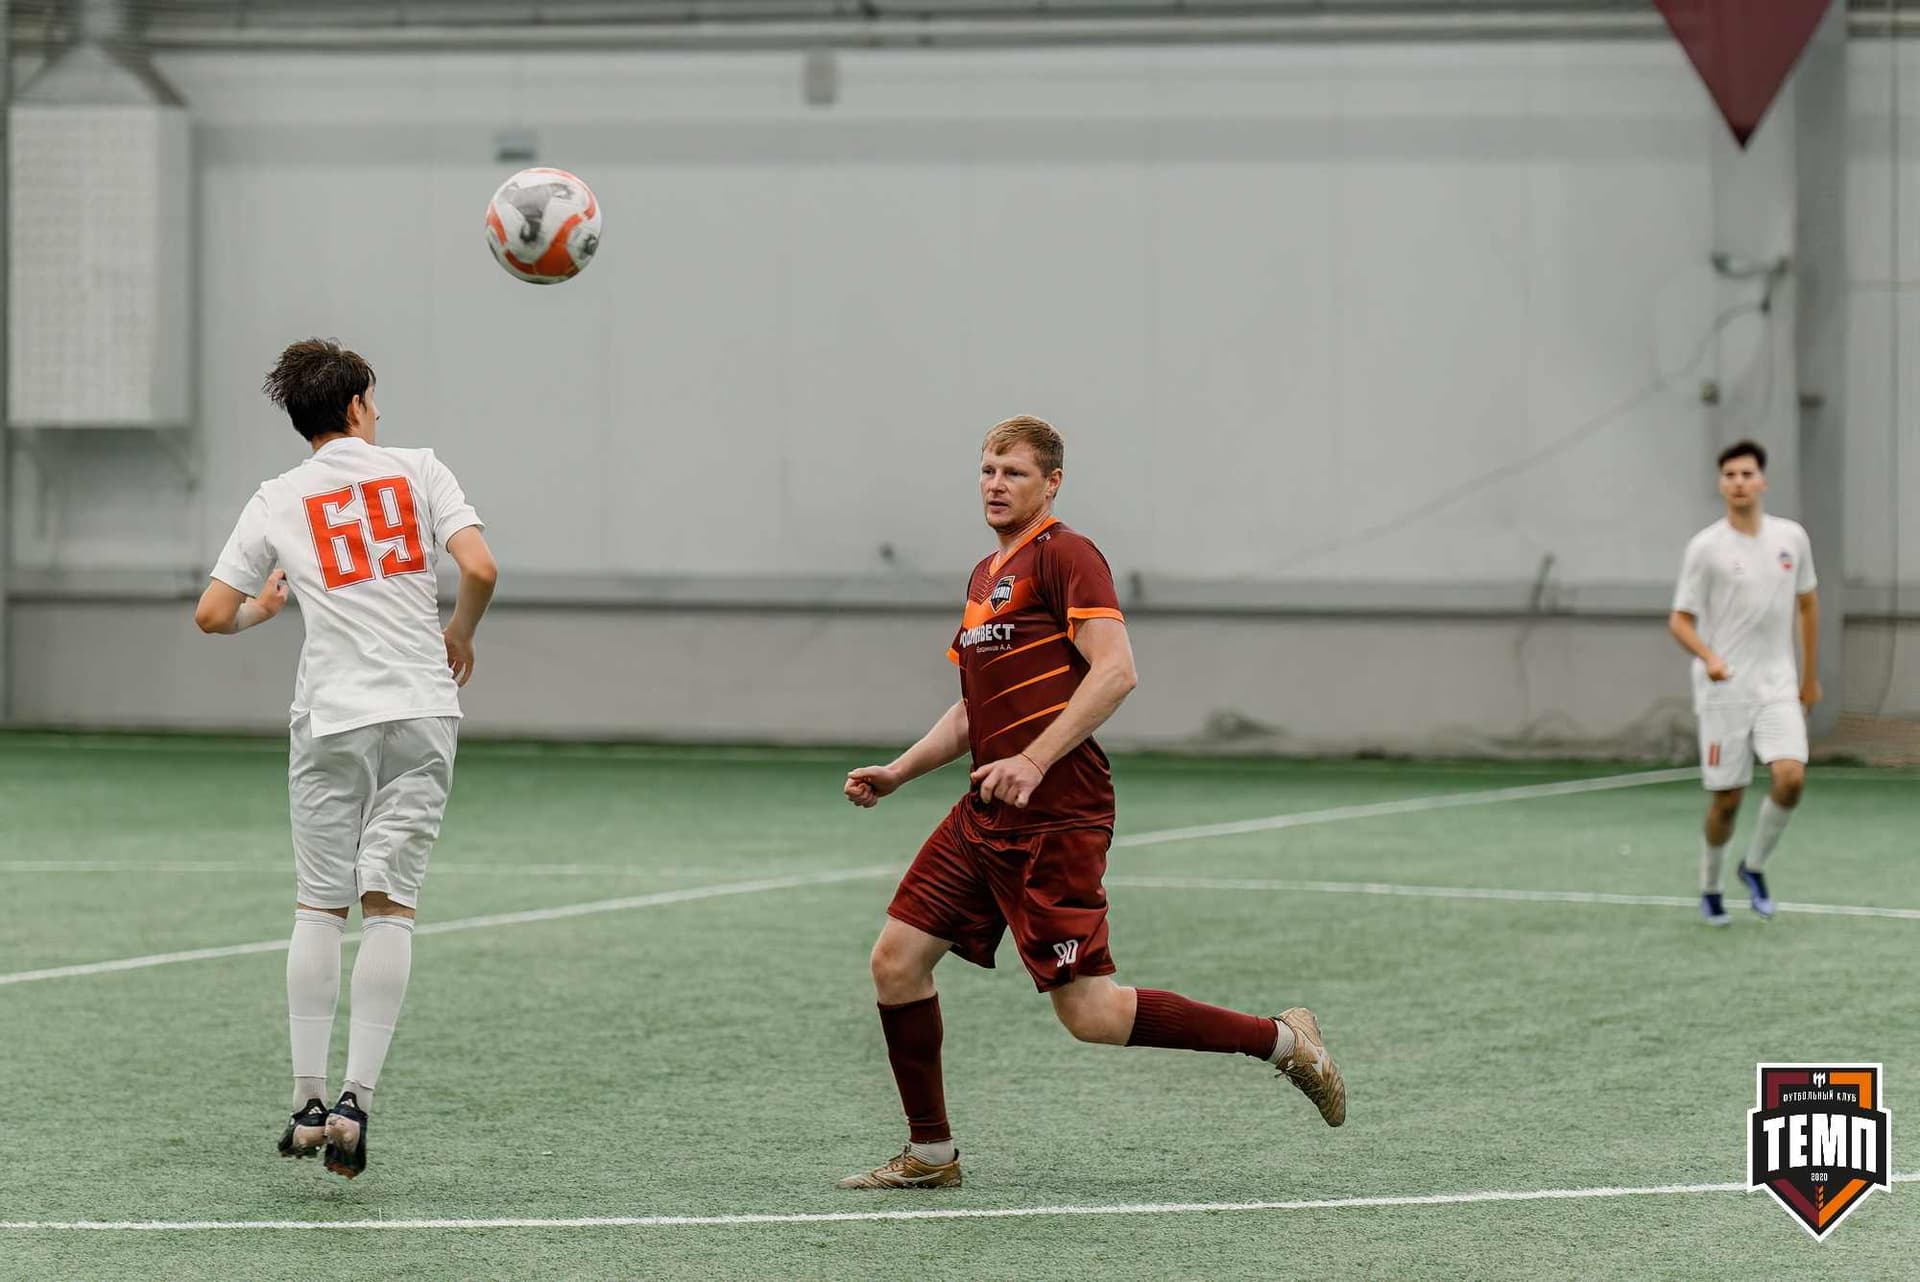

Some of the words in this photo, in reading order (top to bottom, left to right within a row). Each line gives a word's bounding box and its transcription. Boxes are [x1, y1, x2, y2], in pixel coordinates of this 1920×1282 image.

[301, 474, 428, 592] 69
[992, 586, 1011, 600] ТЕМП
[1053, 939, 1079, 968] 90
